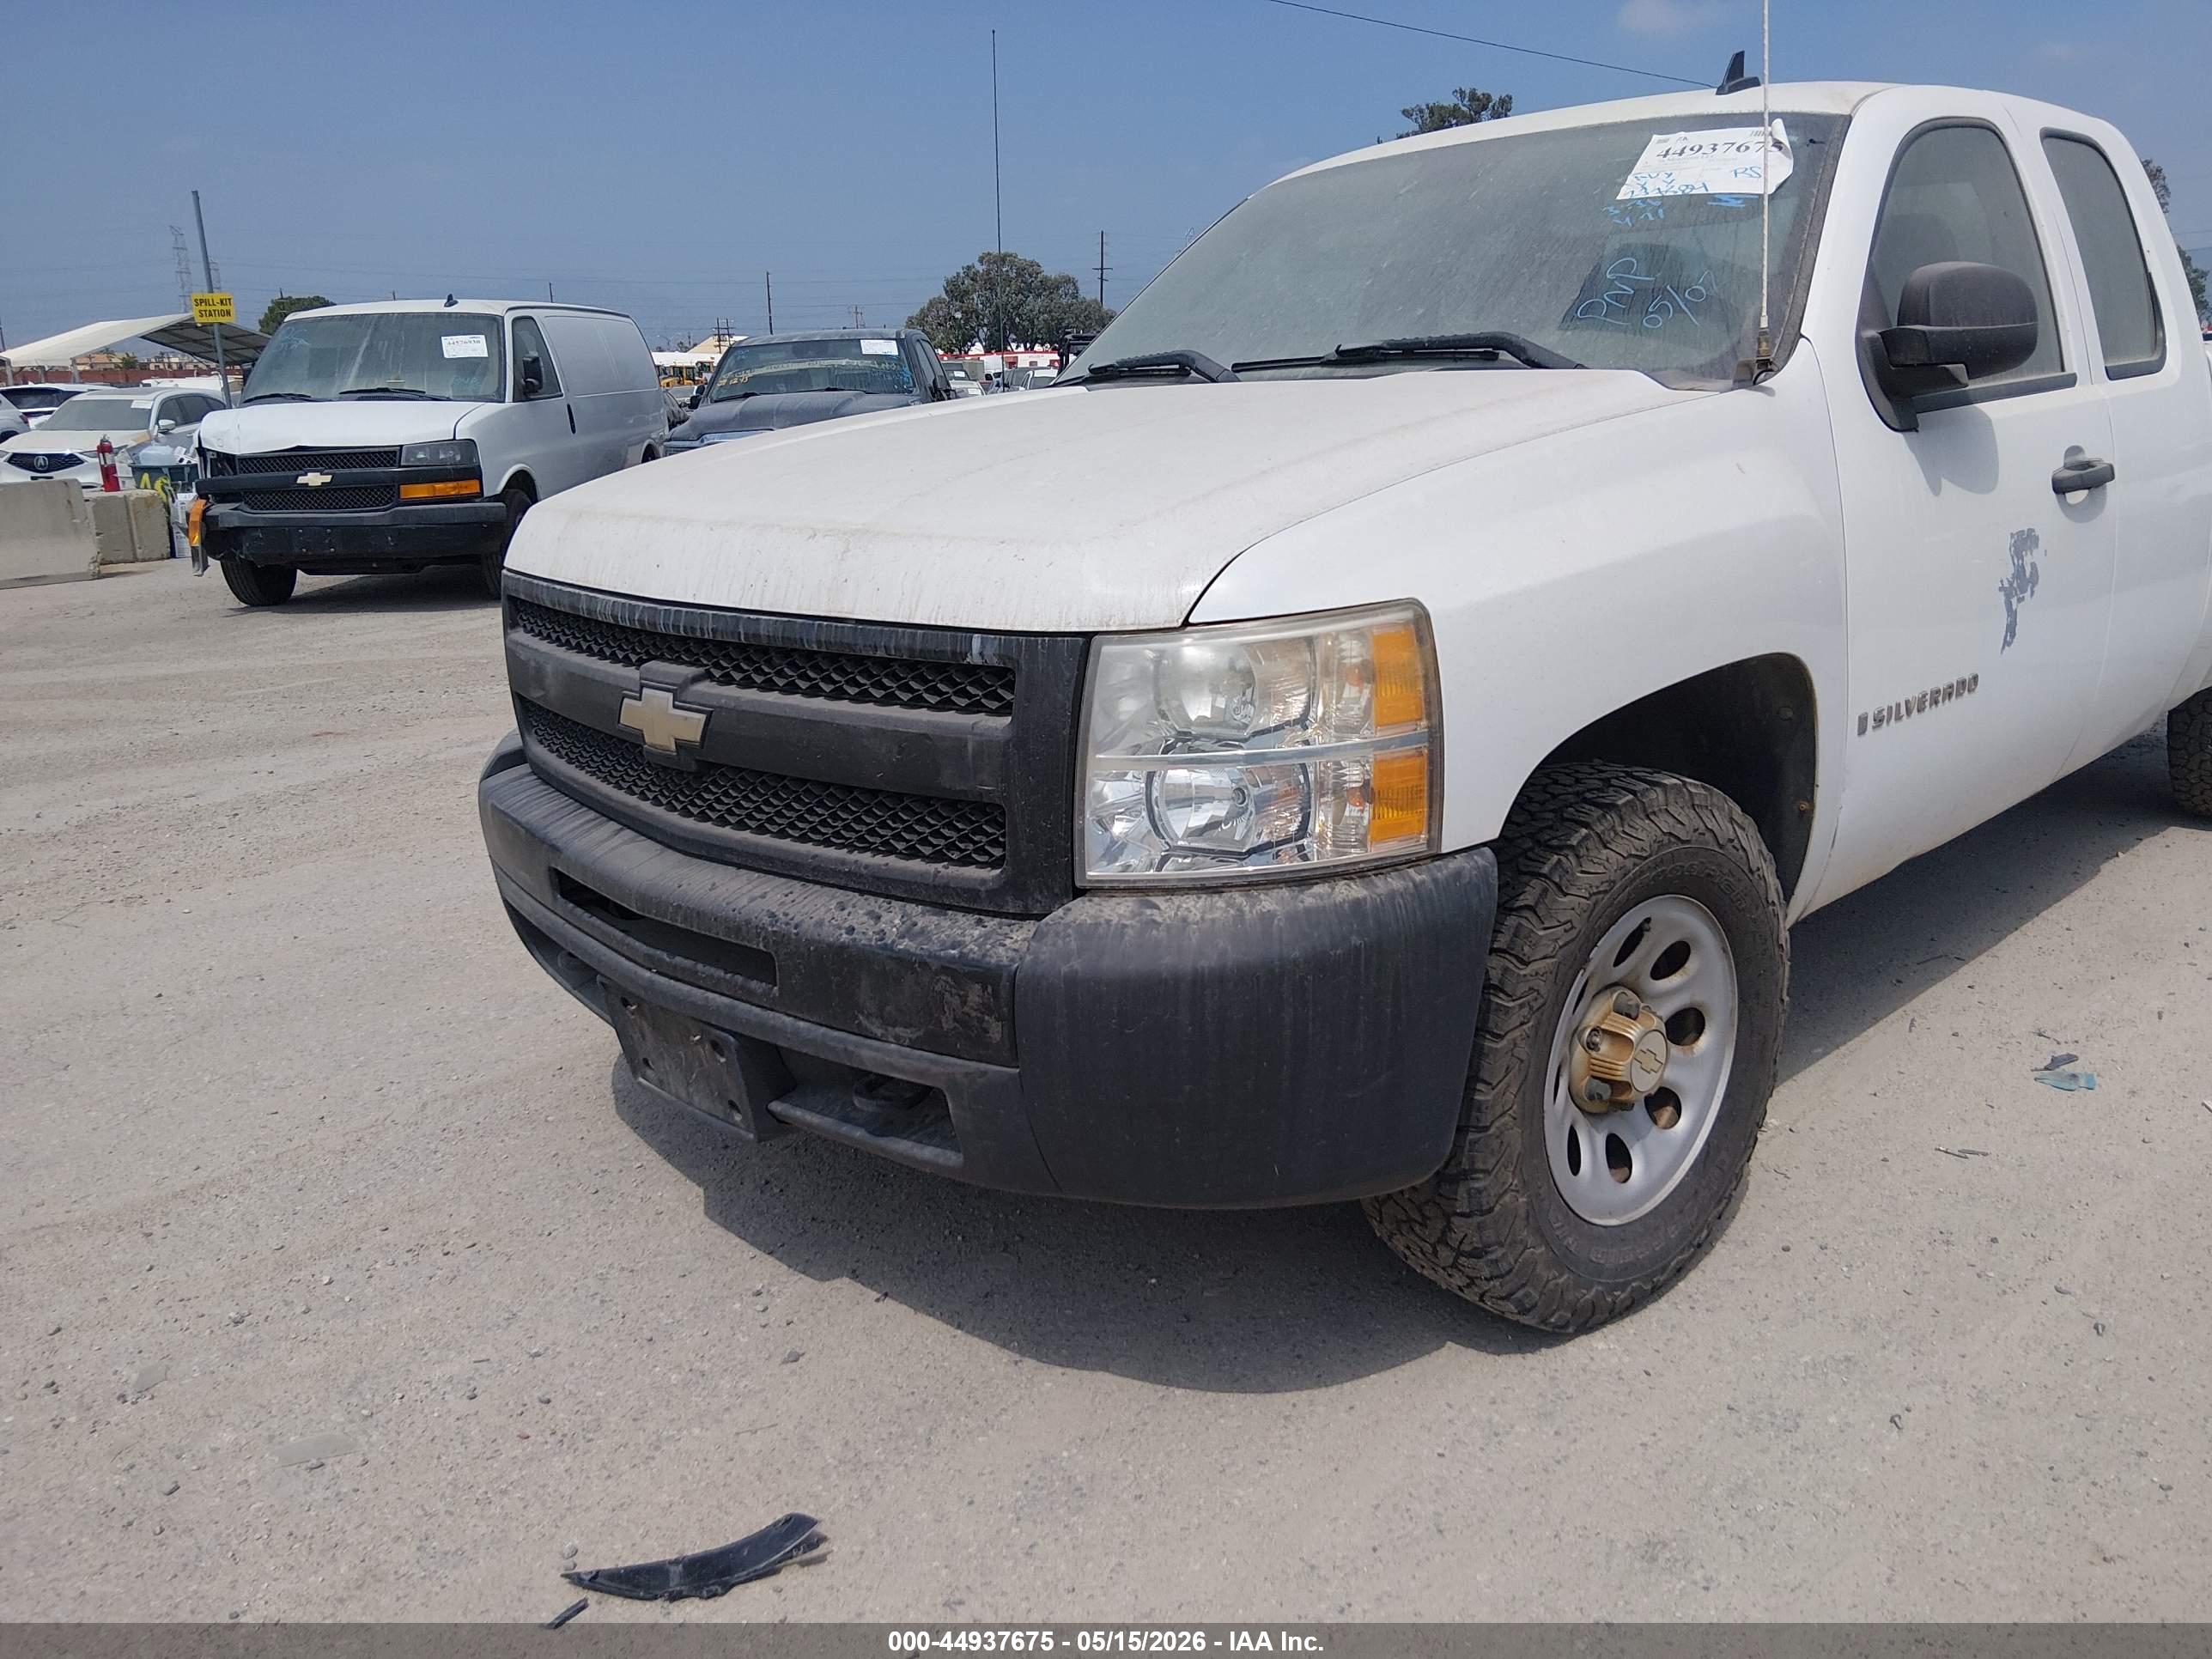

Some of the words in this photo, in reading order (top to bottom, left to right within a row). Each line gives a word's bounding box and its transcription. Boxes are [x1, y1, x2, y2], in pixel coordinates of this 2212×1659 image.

[1656, 140, 1784, 159] 44937675
[194, 297, 232, 307] SPILL-KIT
[198, 309, 232, 318] STATION
[1872, 673, 1979, 730] SILVERADO
